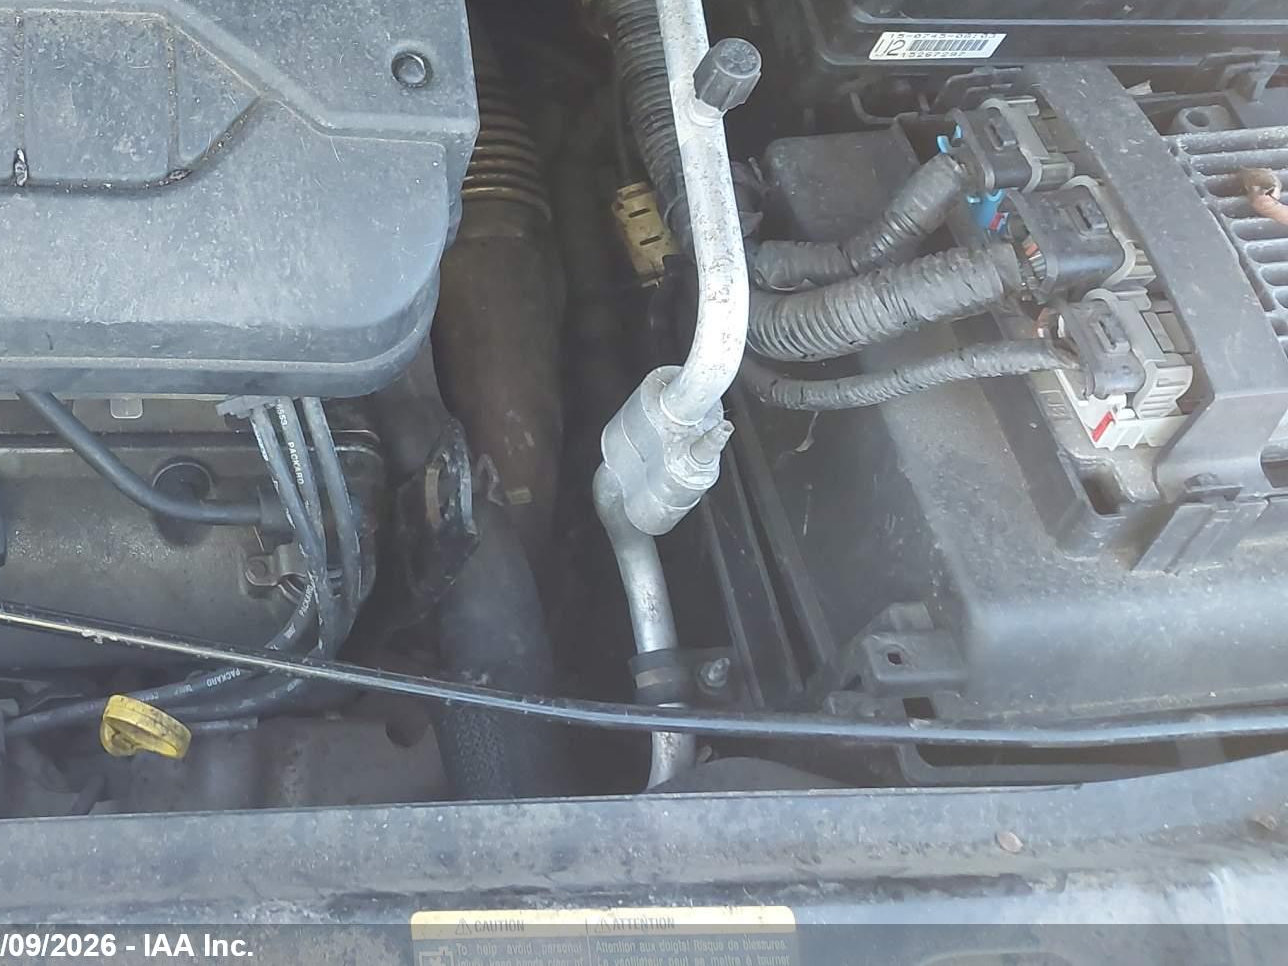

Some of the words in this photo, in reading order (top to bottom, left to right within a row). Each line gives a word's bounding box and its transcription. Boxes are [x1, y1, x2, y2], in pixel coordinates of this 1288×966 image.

[287, 441, 305, 485] PACKARD
[206, 667, 241, 687] PACKARD
[474, 918, 526, 933] CAUTION
[612, 916, 675, 931] ATTENTION
